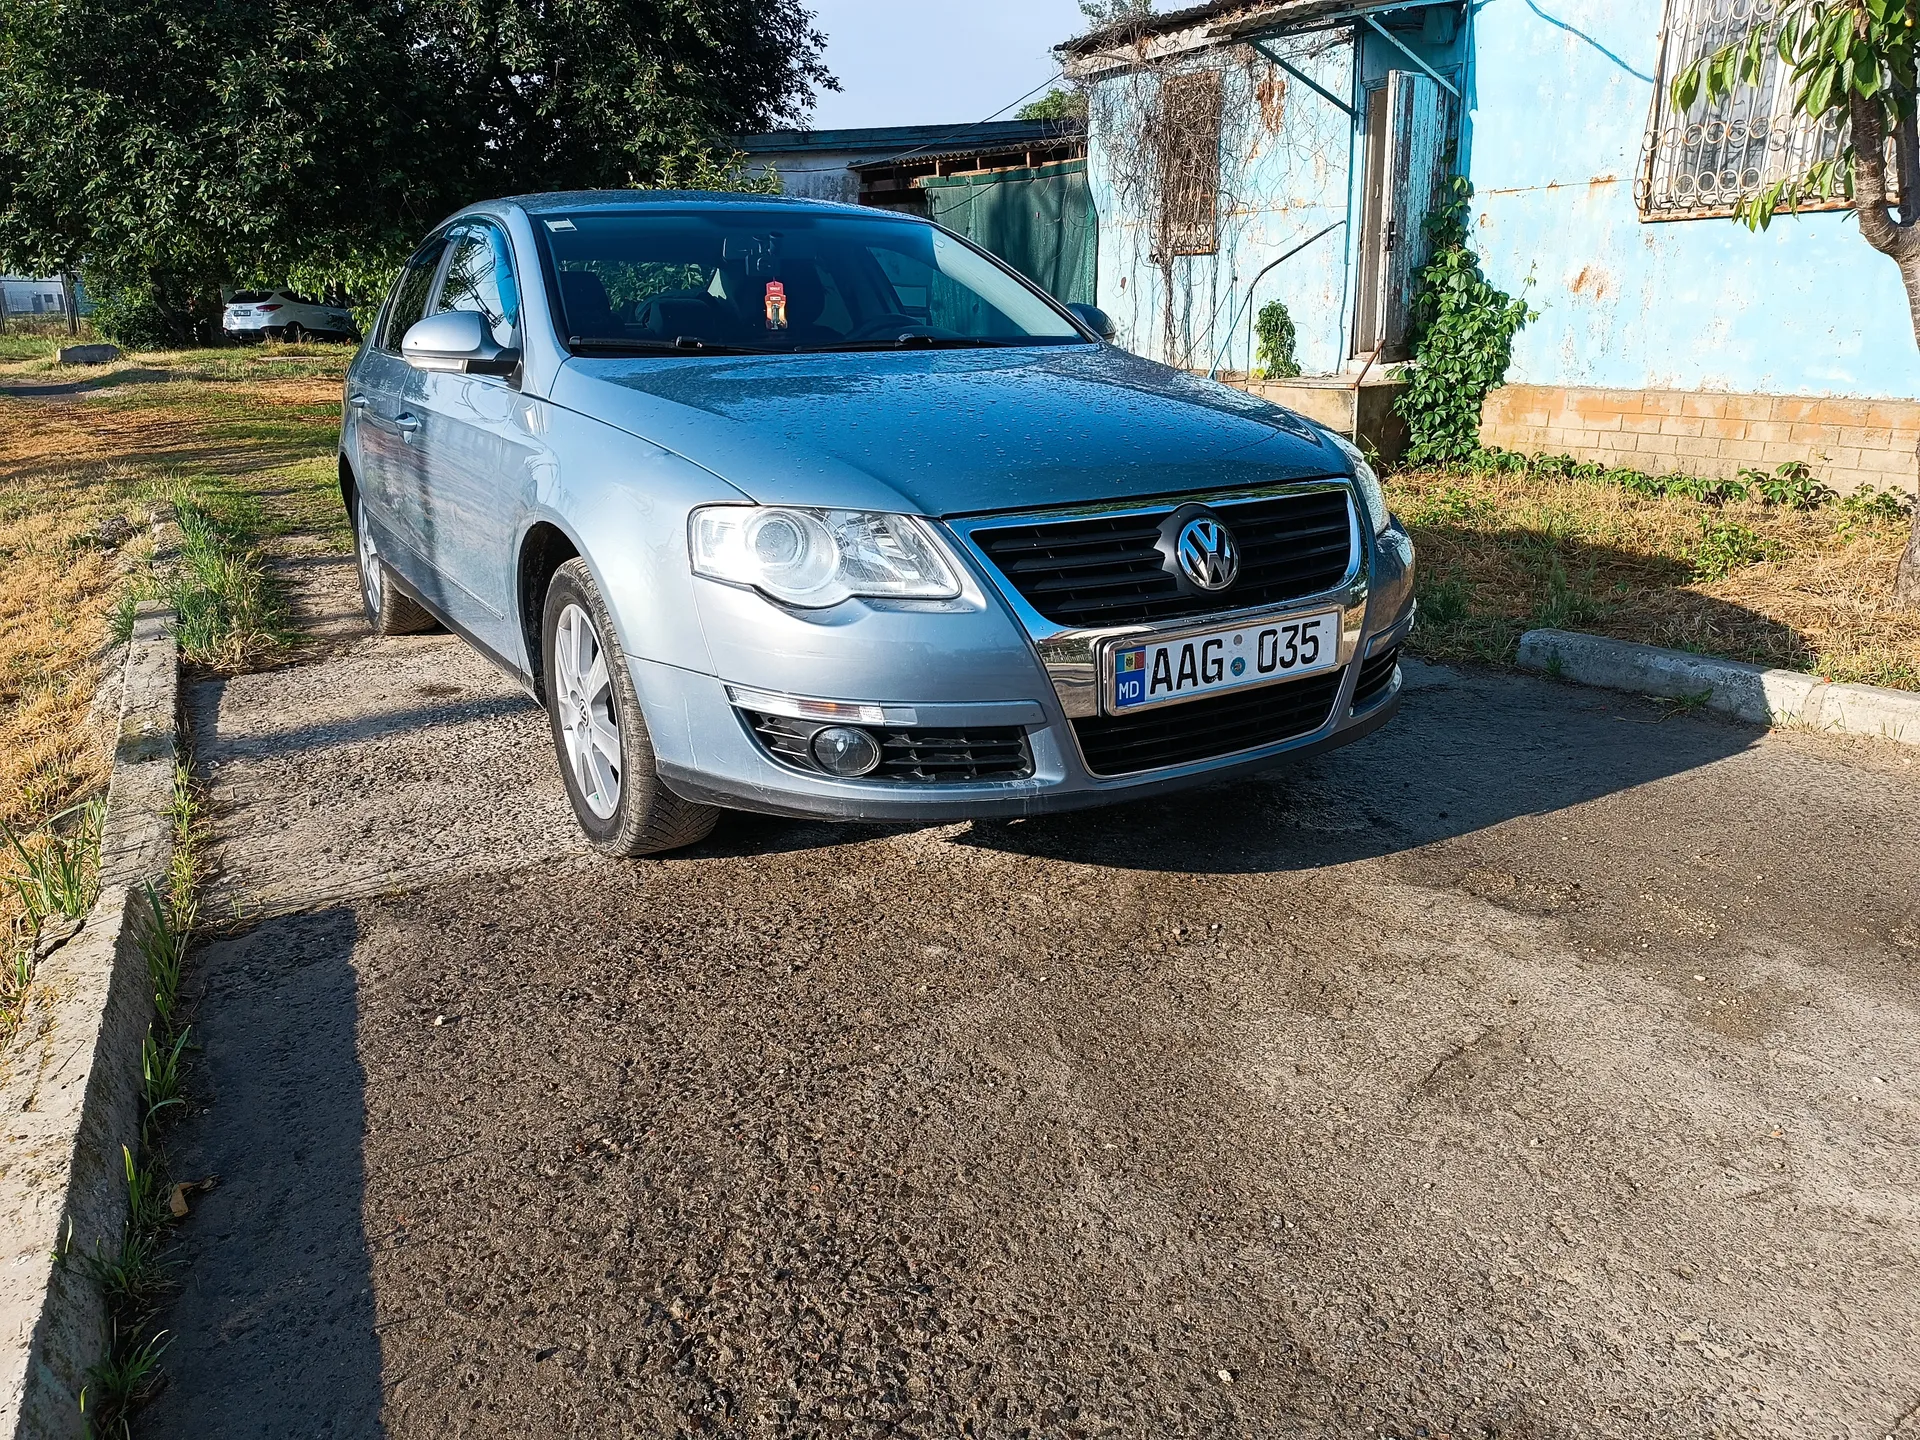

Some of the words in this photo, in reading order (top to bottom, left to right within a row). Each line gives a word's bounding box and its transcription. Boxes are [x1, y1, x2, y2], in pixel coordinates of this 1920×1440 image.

[1179, 518, 1239, 590] VW
[1118, 680, 1140, 700] MD
[1149, 638, 1225, 695] AAG
[1256, 620, 1321, 674] 035
